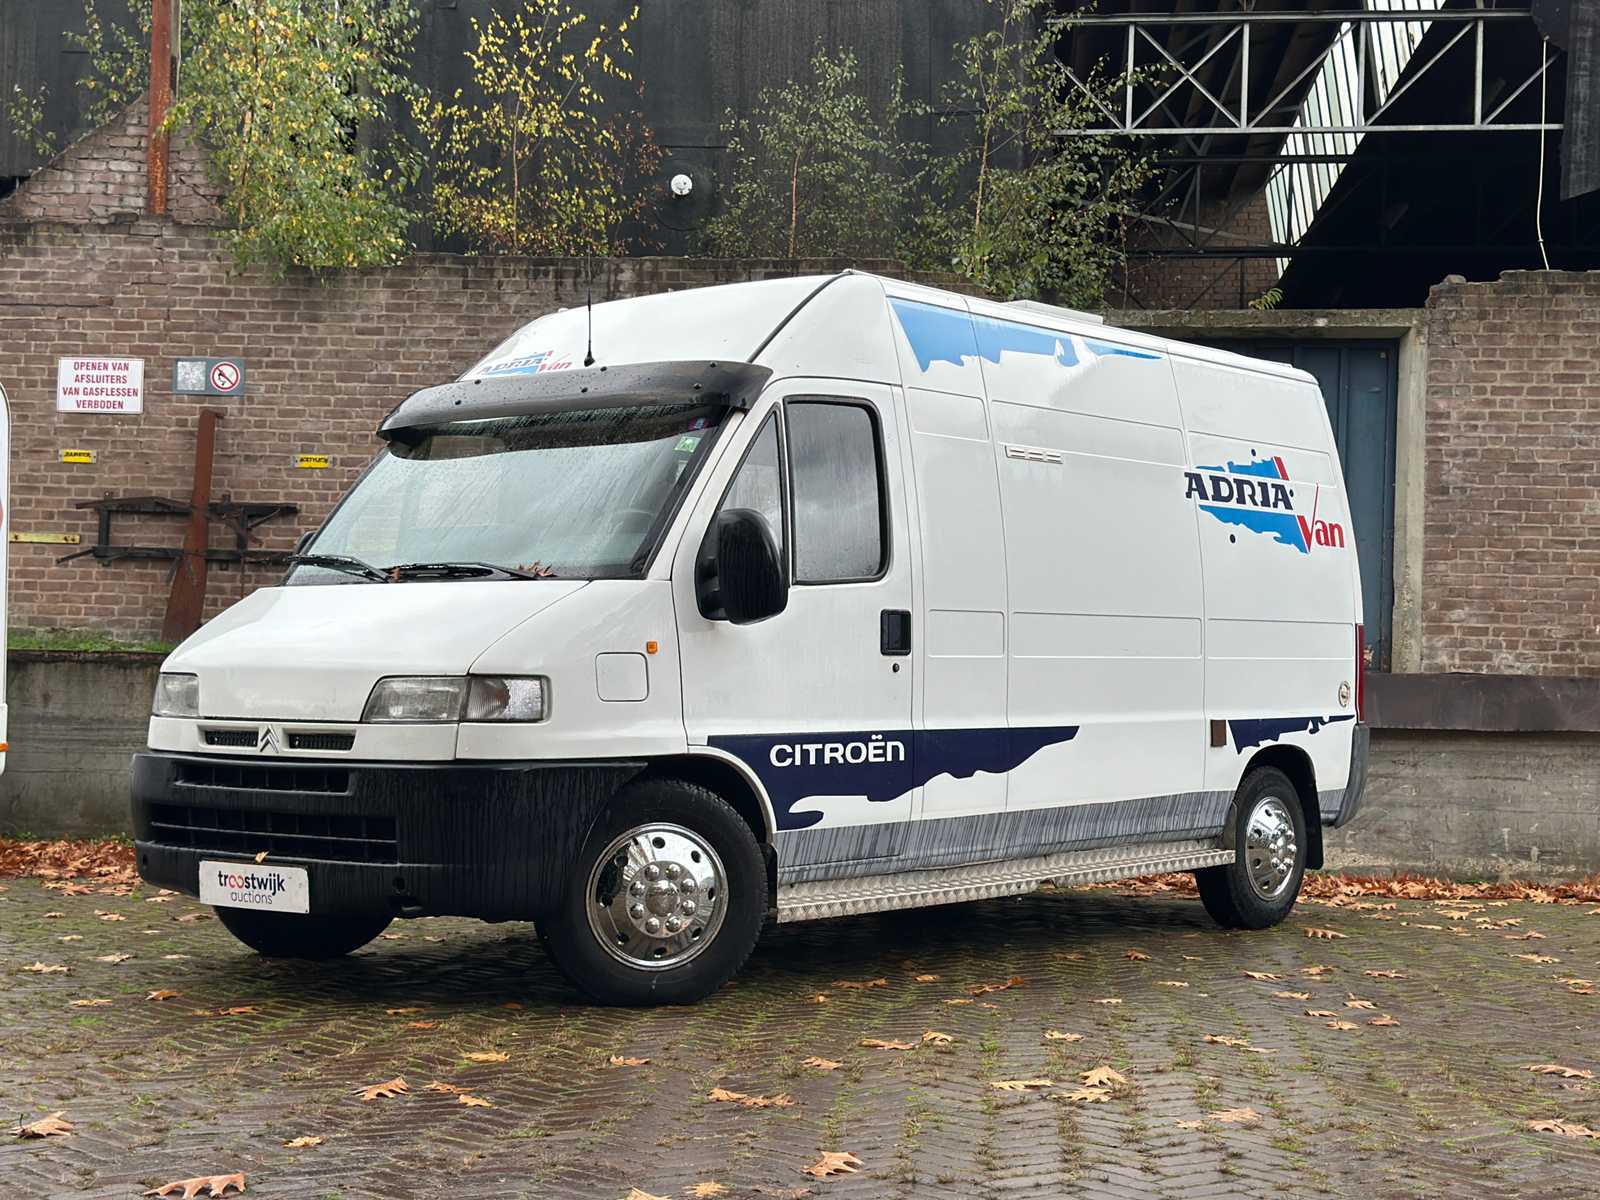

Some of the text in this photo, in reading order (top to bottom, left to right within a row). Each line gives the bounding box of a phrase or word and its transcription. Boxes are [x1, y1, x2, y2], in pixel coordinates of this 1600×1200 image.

[73, 361, 130, 371] OPENEN VAN
[479, 354, 572, 374] ADRIA Van
[74, 374, 128, 384] AFSLUITERS
[62, 386, 139, 397] VAN GASFLESSEN
[76, 399, 124, 409] VERBODEN
[1184, 471, 1345, 553] ADRIA Van
[217, 870, 286, 896] troostwijk
[230, 891, 273, 905] auctions
